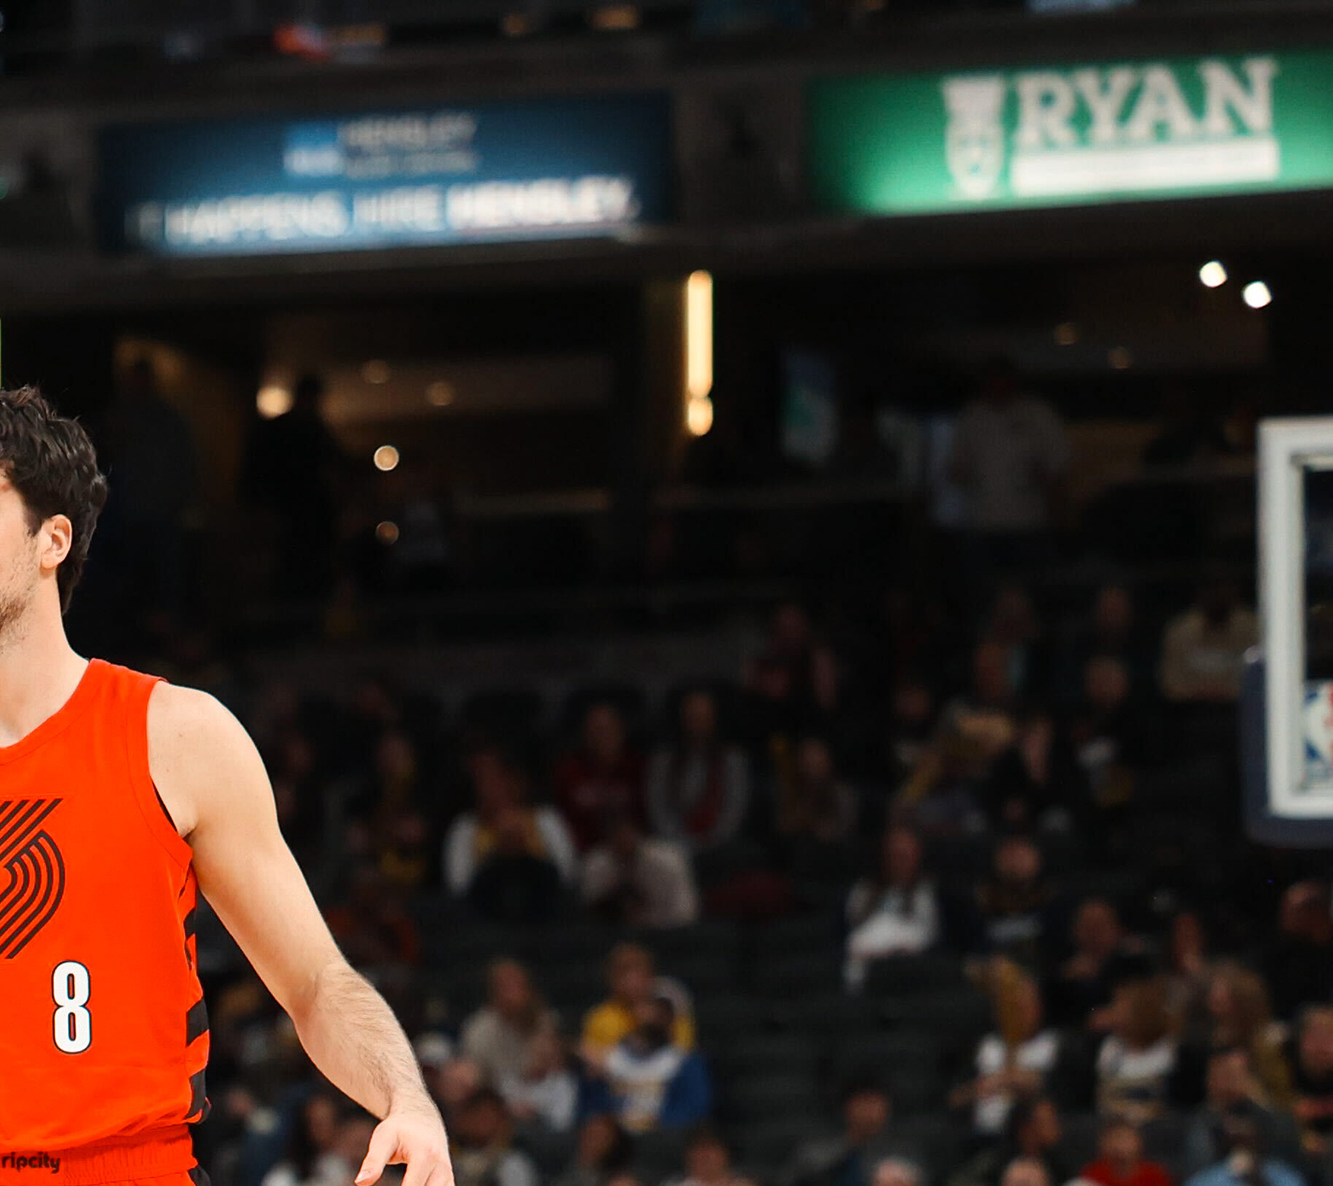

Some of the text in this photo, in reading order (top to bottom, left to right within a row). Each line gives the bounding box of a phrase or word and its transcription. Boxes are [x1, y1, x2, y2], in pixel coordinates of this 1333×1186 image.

[1016, 56, 1275, 146] RYAN
[51, 960, 92, 1055] 8
[2, 1151, 60, 1174] ripcity
